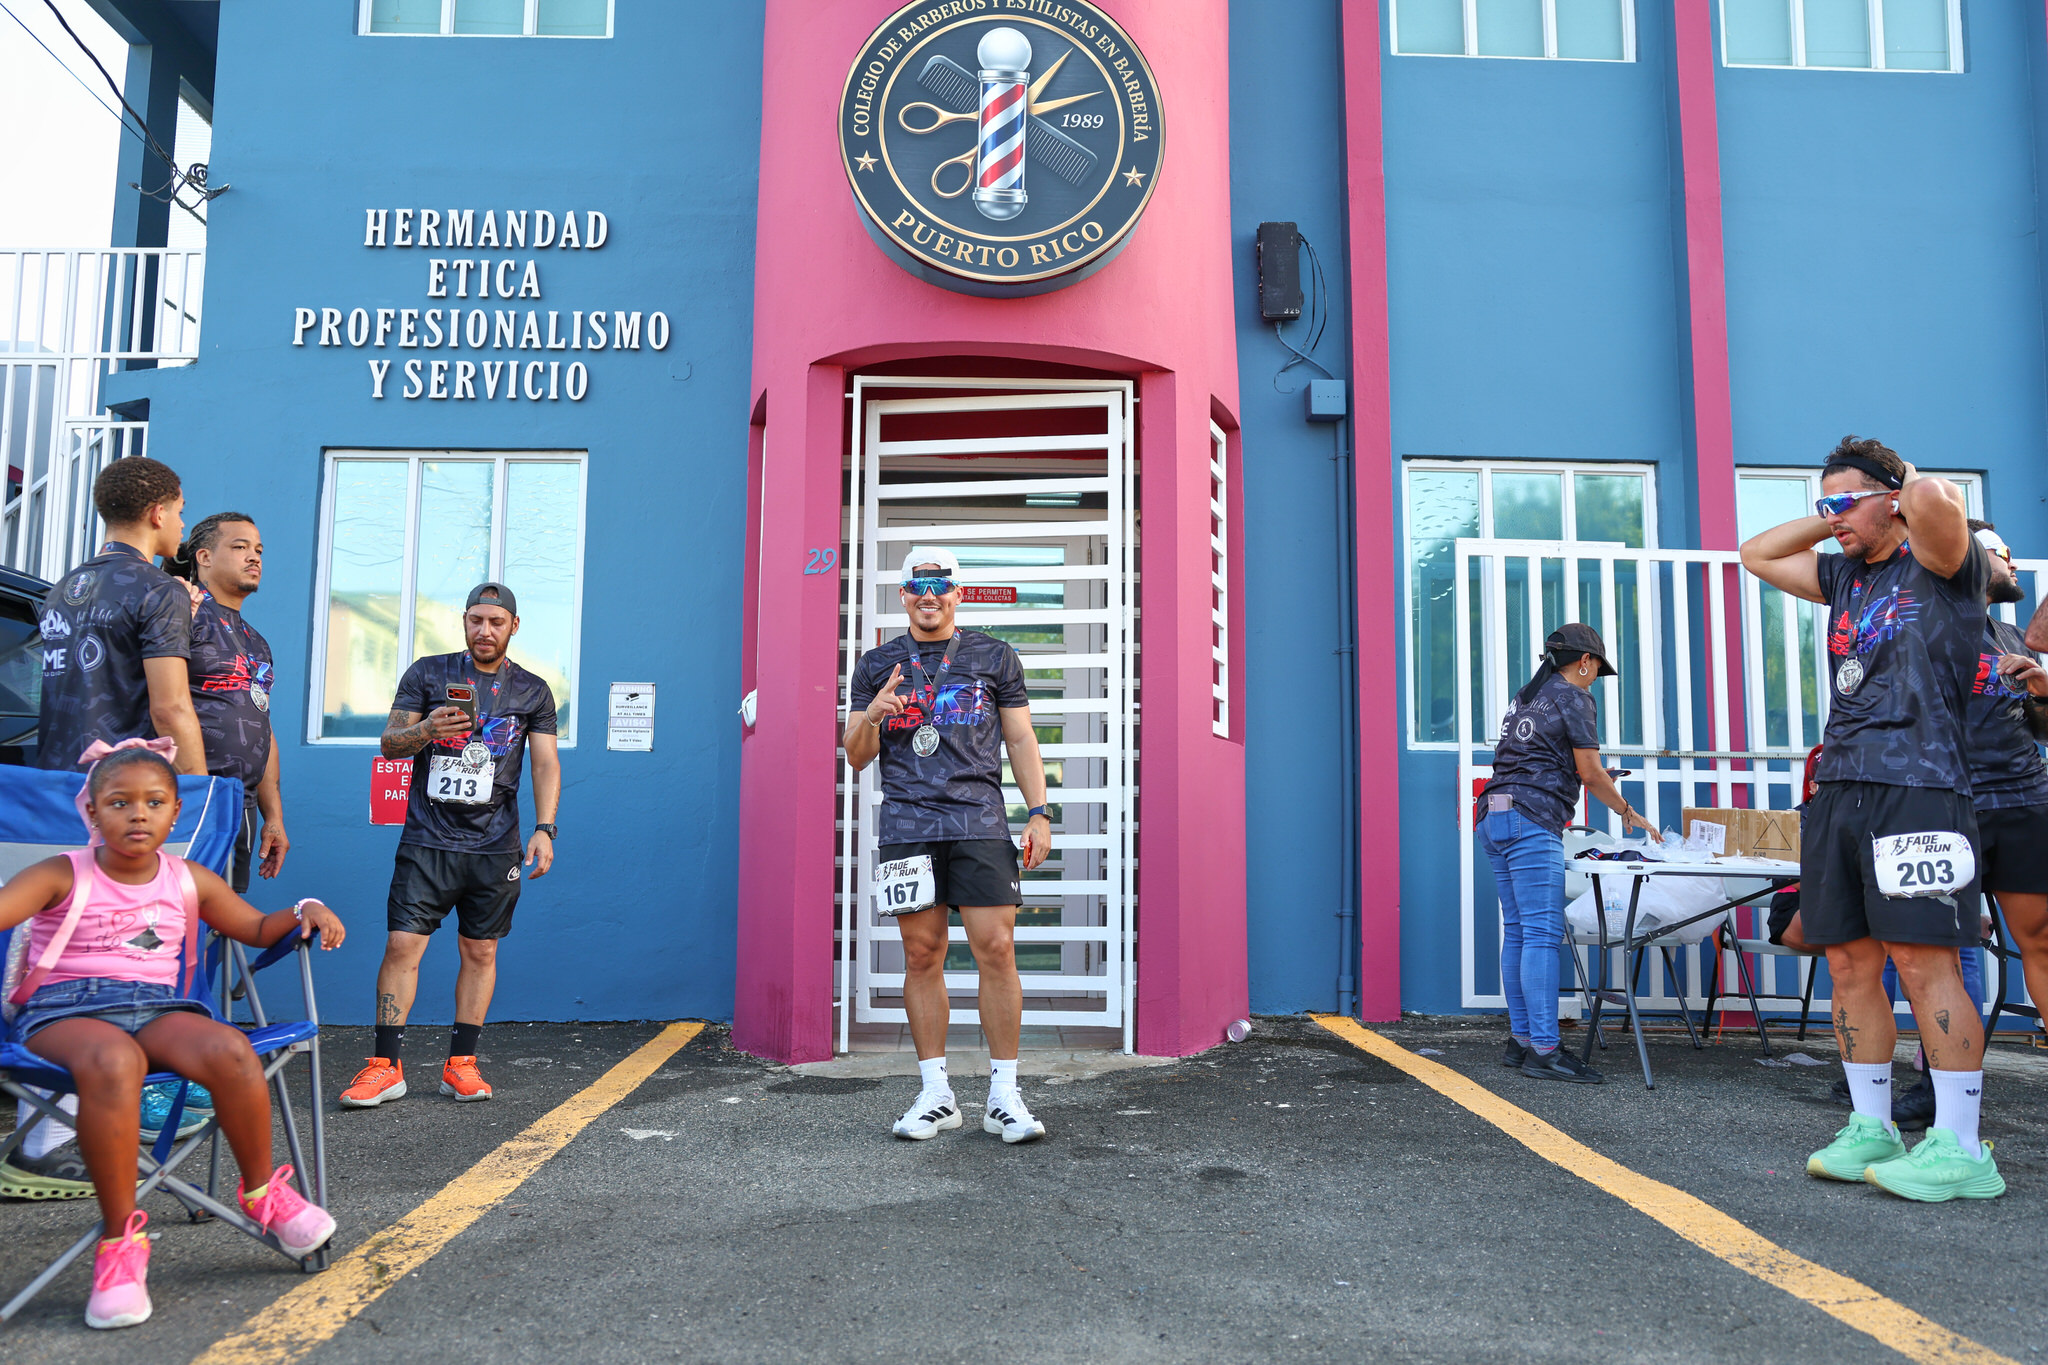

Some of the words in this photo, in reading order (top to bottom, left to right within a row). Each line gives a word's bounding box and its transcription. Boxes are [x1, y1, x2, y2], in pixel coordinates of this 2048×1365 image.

[854, 60, 885, 136] COLEGIO
[877, 37, 903, 62] DE
[897, 0, 987, 43] BARBEROS
[1005, 0, 1099, 39] ESTILISTAS
[1095, 34, 1120, 58] EN
[1060, 113, 1104, 129] 1989
[363, 208, 609, 249] HERMANDAD
[891, 208, 1019, 268] PUERTO
[1028, 221, 1104, 266] RICO
[426, 258, 541, 298] ETICA
[292, 307, 670, 350] PROFESIONALISMO
[368, 359, 391, 399] Y
[403, 359, 588, 401] SERVICIO
[804, 548, 837, 575] 29
[201, 679, 251, 692] FADE
[615, 718, 647, 727] AVISO
[931, 714, 944, 726] &
[944, 712, 980, 727] RUN
[432, 737, 468, 750] ADE
[377, 762, 413, 773] ESTA
[461, 767, 481, 776] RUN
[438, 776, 478, 797] 213
[384, 789, 409, 801] PAR
[1906, 834, 1939, 847] FADE
[1924, 843, 1952, 854] RUN
[889, 860, 909, 872] FADE
[898, 867, 919, 877] RUN
[1896, 859, 1955, 888] 203
[884, 880, 919, 906] 167
